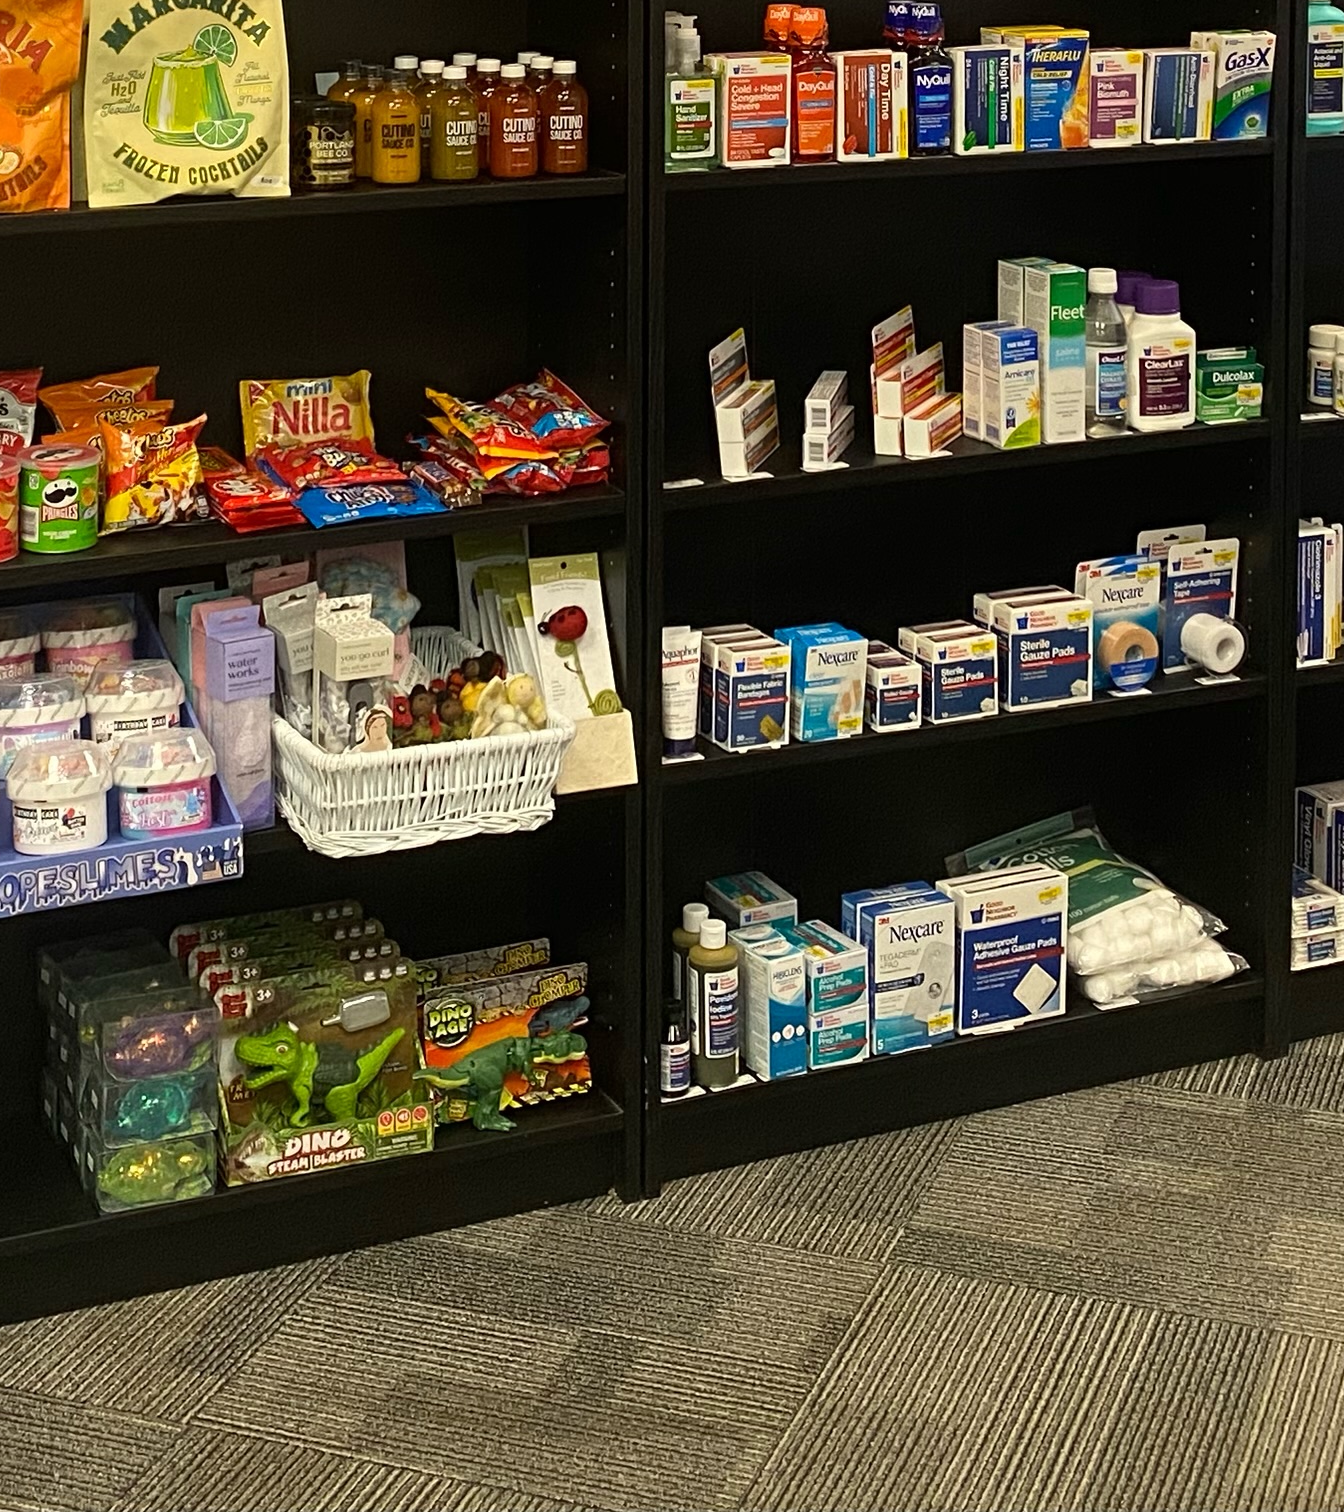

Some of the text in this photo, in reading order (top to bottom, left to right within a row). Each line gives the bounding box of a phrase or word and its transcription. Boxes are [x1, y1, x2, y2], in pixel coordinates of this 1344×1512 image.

[1029, 49, 1081, 63] THERAFLU
[1225, 47, 1271, 72] Gas-X
[881, 63, 890, 120] Day Time
[1000, 57, 1009, 121] Night Time
[1097, 89, 1129, 99] Bismuth
[731, 92, 780, 102] Congestion
[731, 101, 760, 111] Severe
[446, 120, 477, 134] CUTINO
[503, 117, 535, 132] CUTINO
[550, 114, 583, 130] CUTINO
[382, 124, 416, 138] CUTINO
[503, 132, 526, 143] SAUCE
[310, 140, 354, 149] PORTLAND
[446, 136, 469, 146] SAUCE
[113, 137, 268, 186] FROZEN COCKTAILS
[1051, 305, 1085, 320] Fleet
[1144, 359, 1184, 369] ClearLax
[1212, 371, 1254, 382] Dulcolax
[287, 379, 333, 397] mini
[272, 397, 352, 436] Nilla
[42, 505, 78, 520] PRINGLES
[1102, 586, 1144, 603] Nexcare
[1020, 639, 1050, 651] Sterile
[818, 650, 858, 667] Nexcare
[1020, 645, 1075, 662] Gauze Pads
[228, 656, 258, 670] water
[228, 666, 259, 679] works
[889, 920, 944, 943] Nexcare
[973, 935, 1018, 952] Waterproof
[973, 937, 1057, 961] Adhesive Gauze Pads
[773, 966, 802, 981] HIBICLENS
[257, 989, 271, 1001] 3+
[429, 1004, 472, 1028] DINO
[436, 1020, 471, 1038] AGE
[285, 1128, 351, 1157] DINO
[268, 1146, 366, 1175] STEAM BLASTER
